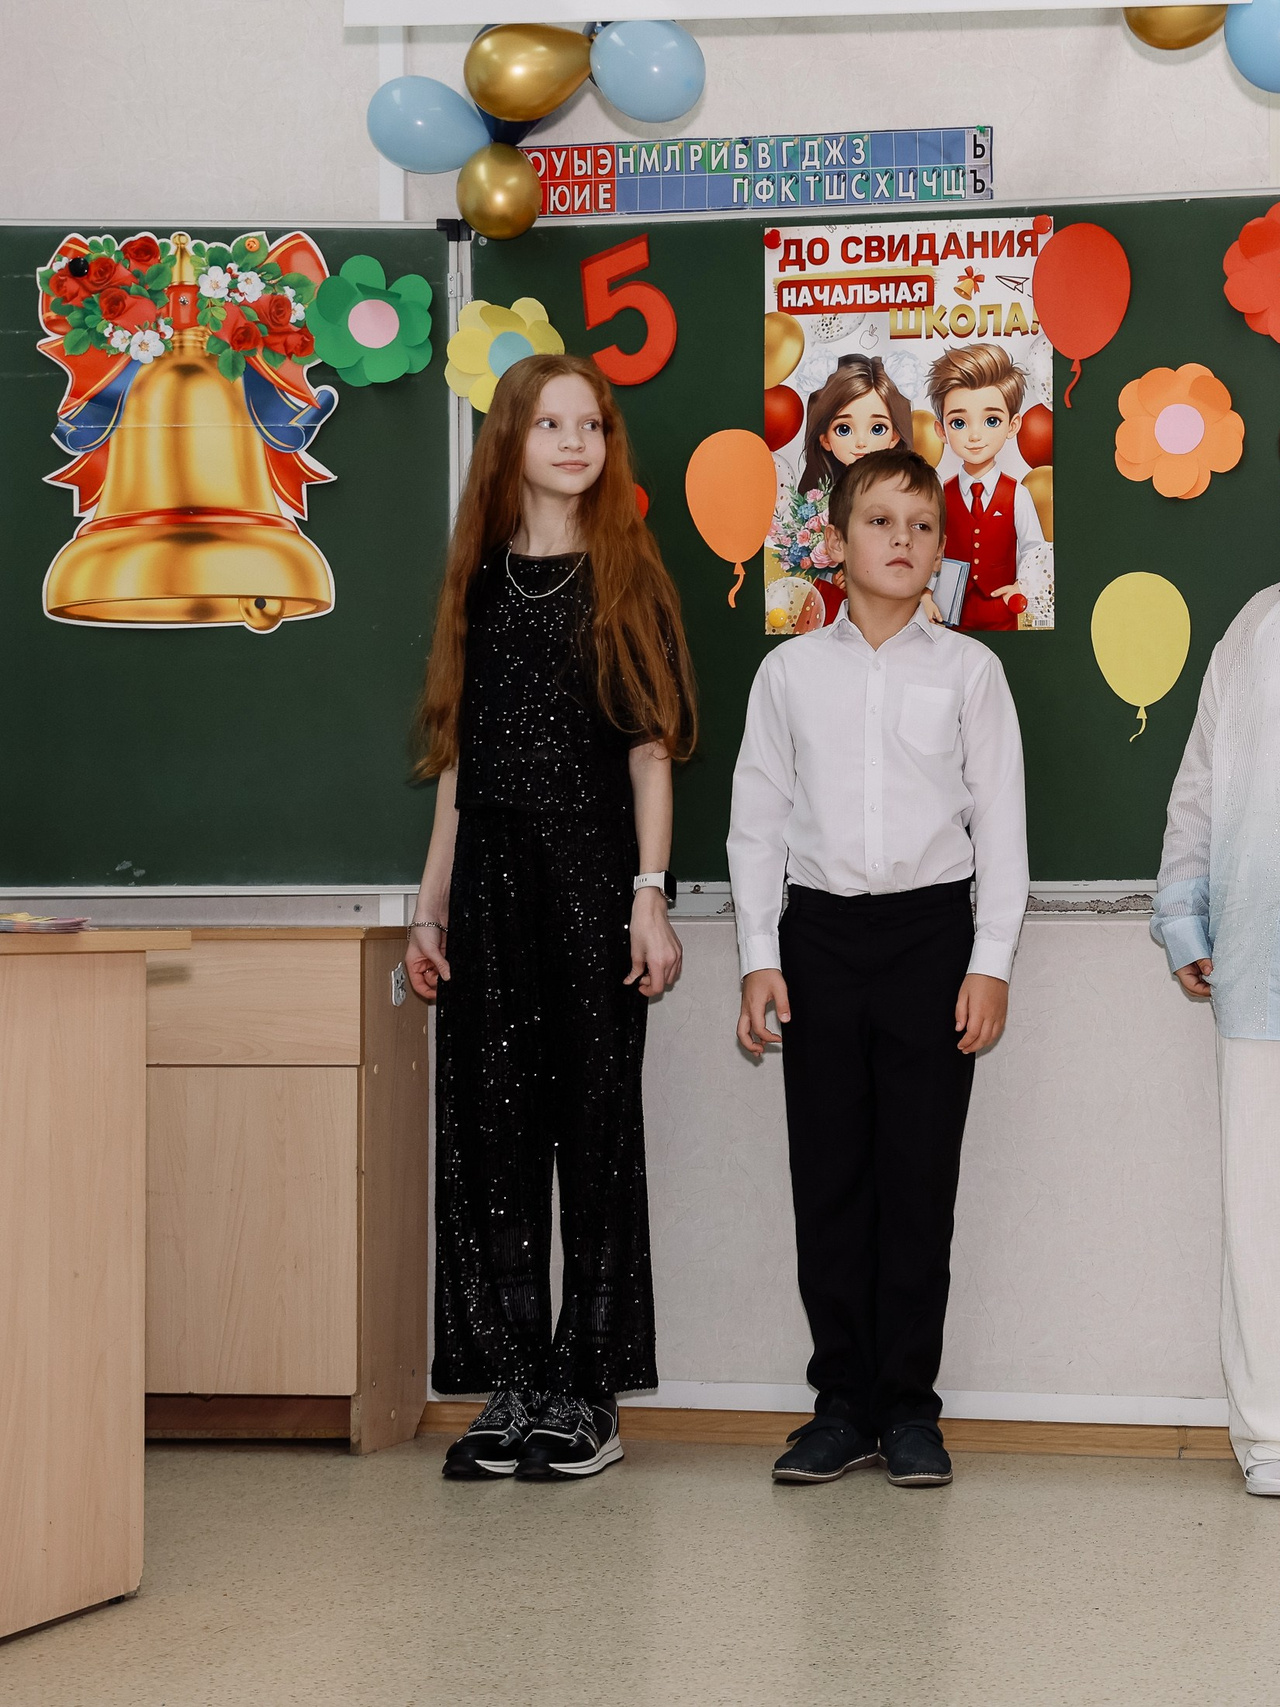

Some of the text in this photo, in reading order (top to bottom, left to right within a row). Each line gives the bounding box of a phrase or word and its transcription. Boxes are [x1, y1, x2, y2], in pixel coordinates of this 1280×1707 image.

[778, 229, 1040, 272] ДО СВИДАНИЯ
[580, 232, 678, 386] 5
[782, 281, 928, 308] НАЧАЛЬНАЯ
